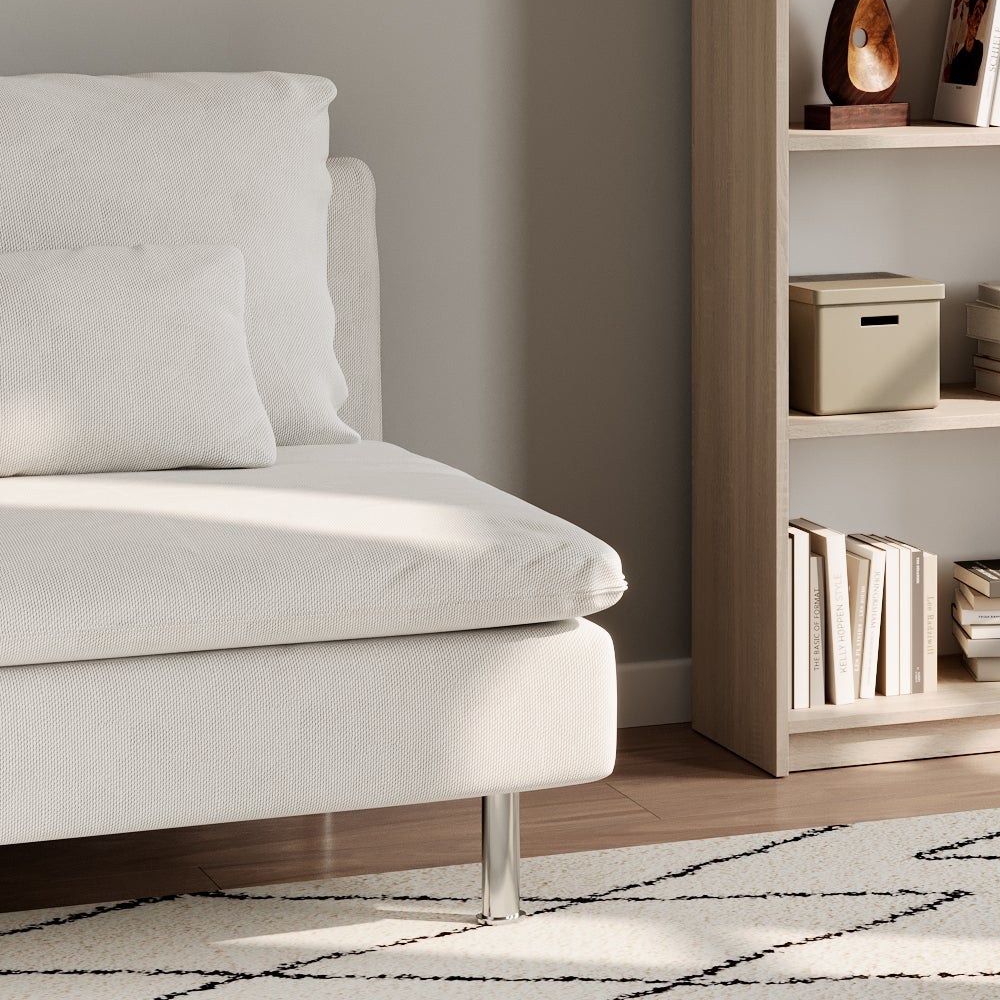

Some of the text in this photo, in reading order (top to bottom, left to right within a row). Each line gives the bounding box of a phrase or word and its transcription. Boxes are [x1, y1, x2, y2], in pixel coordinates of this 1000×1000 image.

[814, 620, 820, 632] OF
[833, 574, 848, 674] KELLY HOPPEN STYLE
